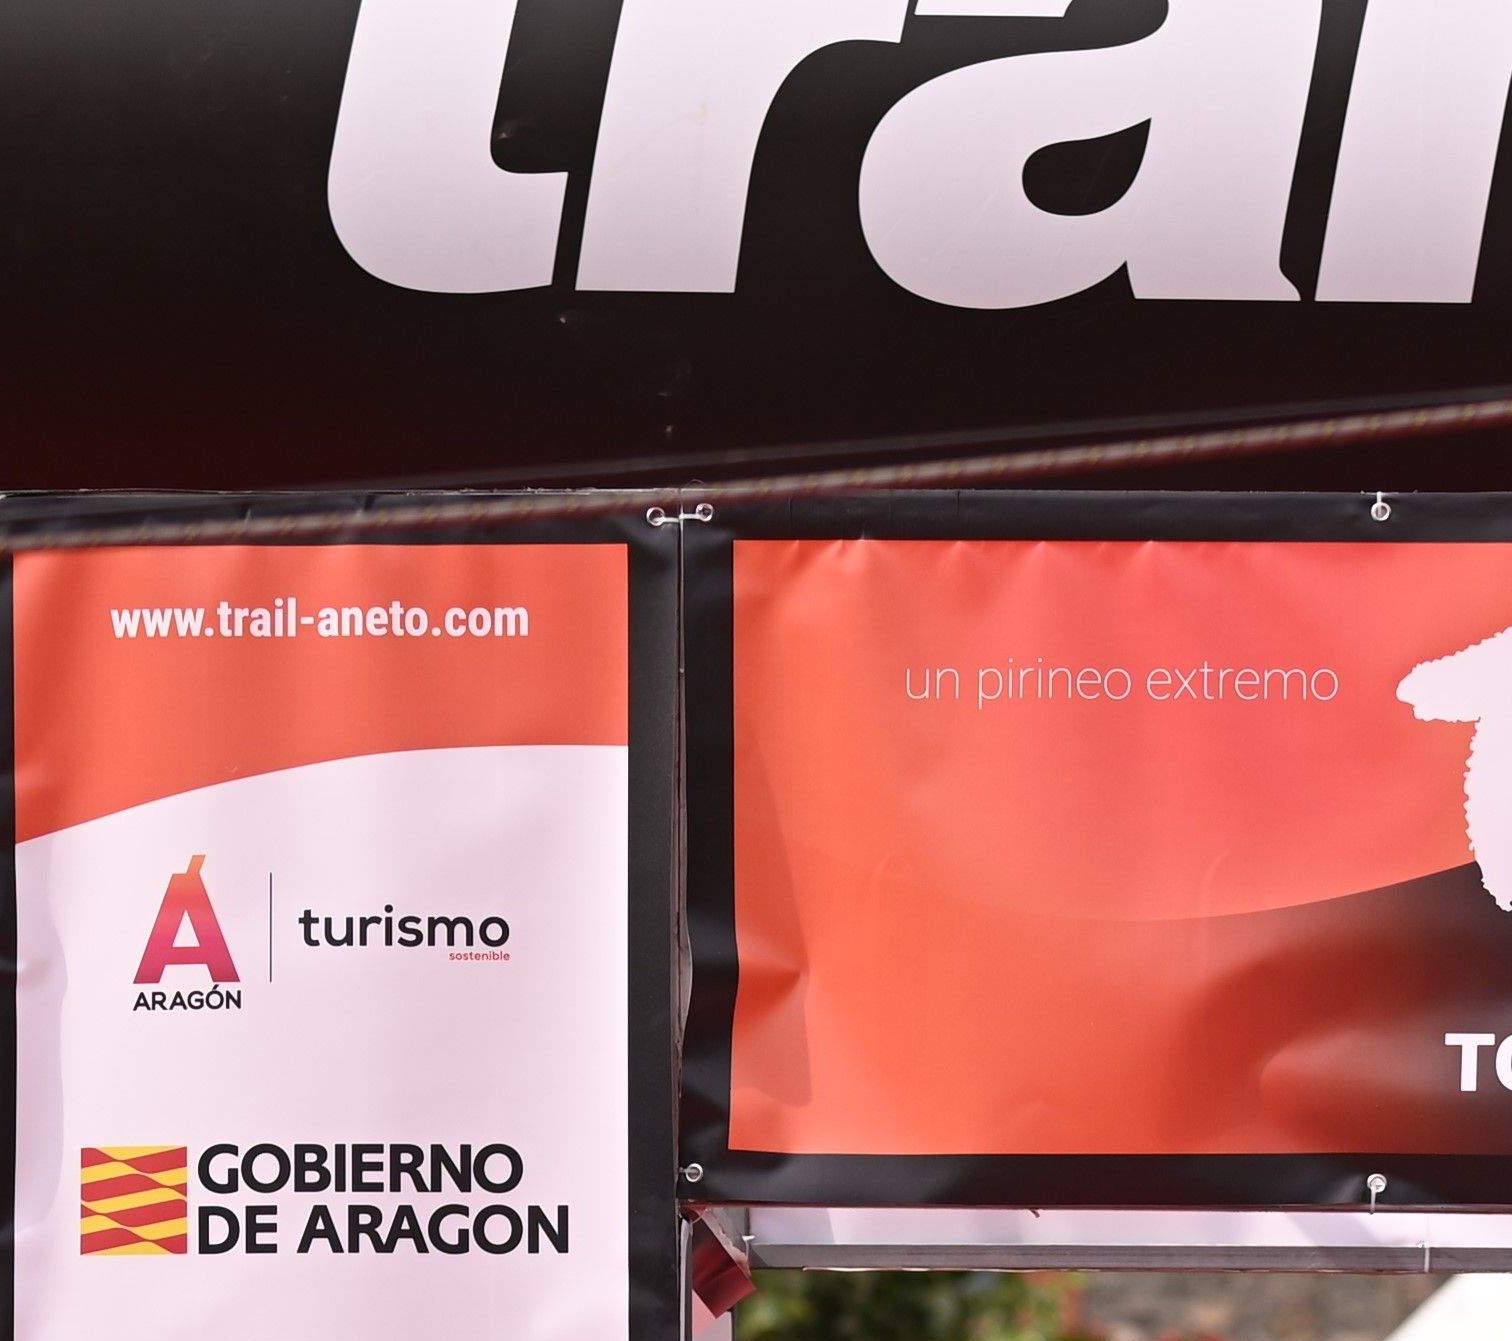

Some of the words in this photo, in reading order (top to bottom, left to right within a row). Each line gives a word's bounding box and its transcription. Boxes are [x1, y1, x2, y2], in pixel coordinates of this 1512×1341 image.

[110, 598, 529, 638] www.trail-aneto.com
[906, 669, 960, 700] un
[978, 660, 1132, 709] pirineo
[1146, 664, 1339, 702] extremo
[298, 904, 510, 948] turismo
[448, 951, 510, 962] sostenible
[133, 984, 242, 1011] ARAGÓN
[197, 1144, 523, 1194] GOBIERNO
[199, 1205, 278, 1255] DE
[297, 1204, 570, 1255] ARAGON
